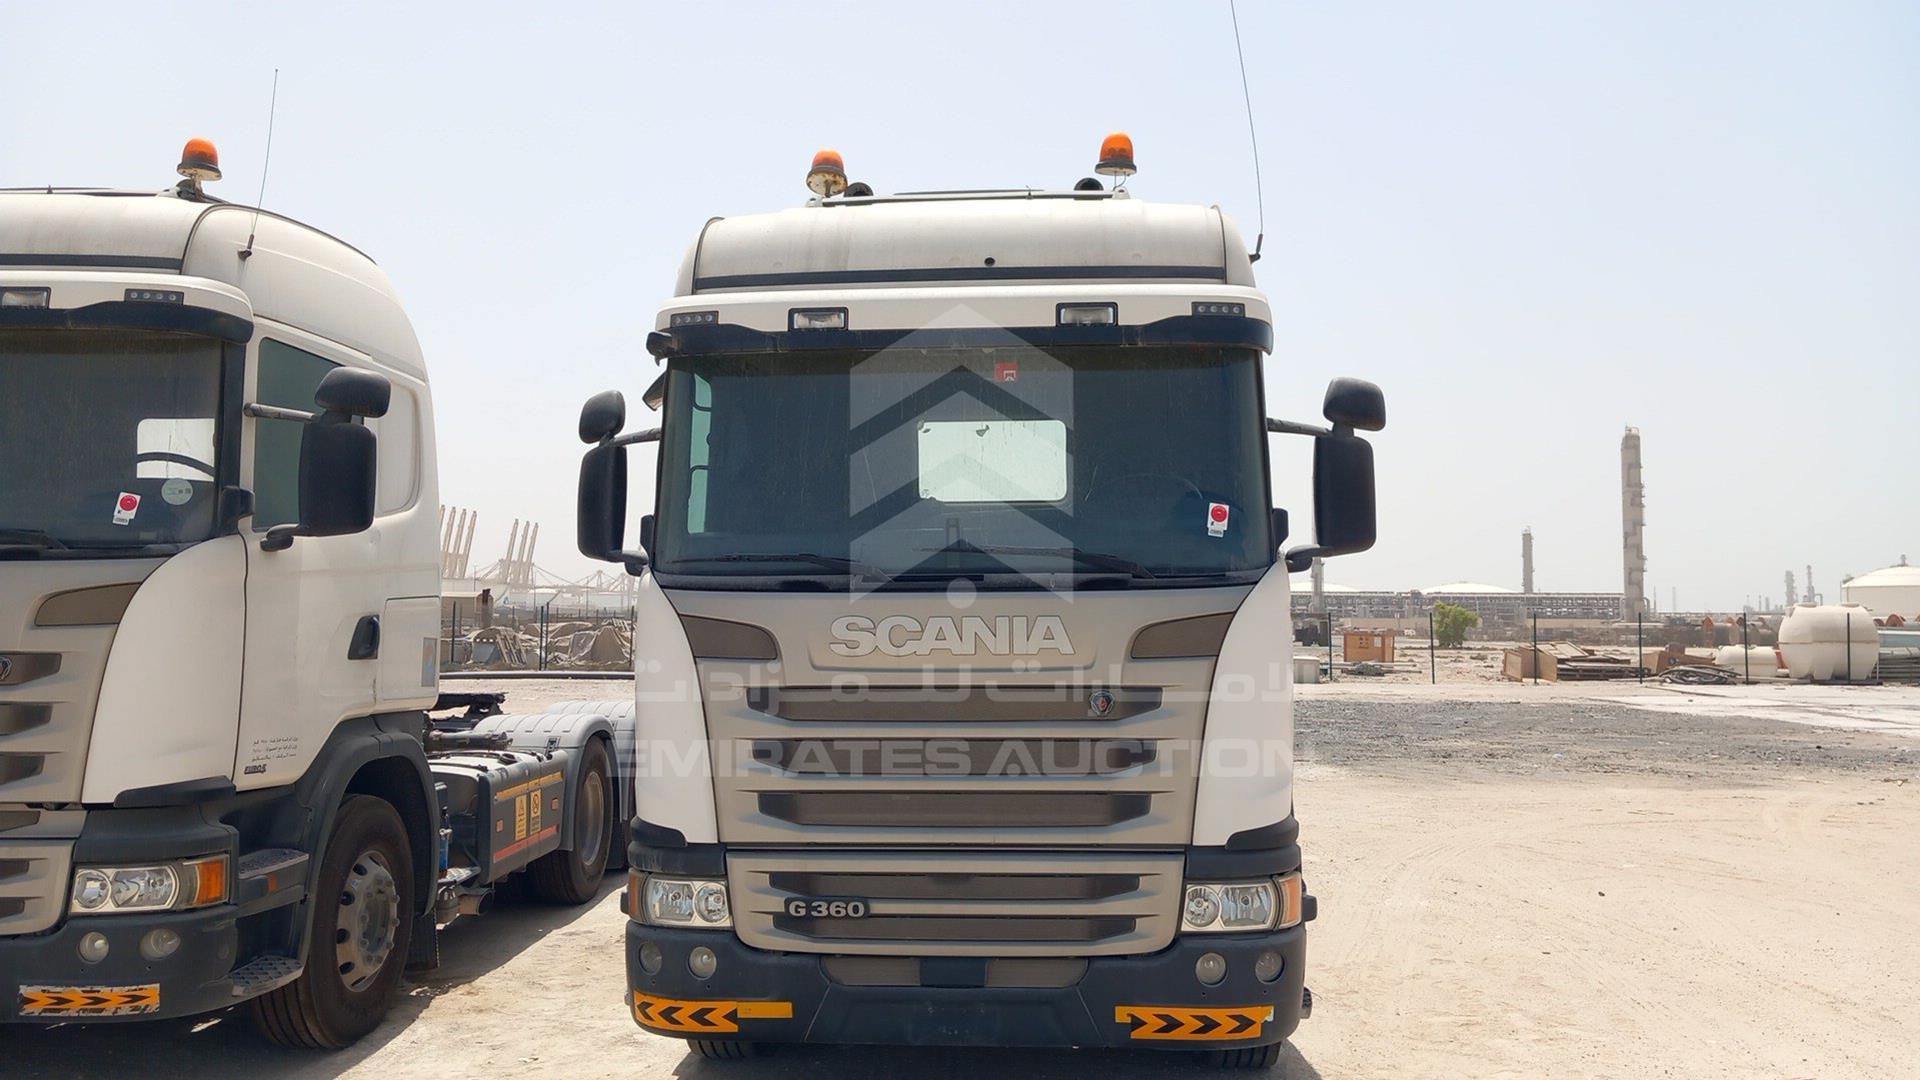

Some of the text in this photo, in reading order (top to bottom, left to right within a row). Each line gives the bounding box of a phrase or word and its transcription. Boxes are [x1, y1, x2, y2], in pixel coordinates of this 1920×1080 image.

[829, 615, 1076, 657] SCANIA
[789, 901, 865, 917] G 360
